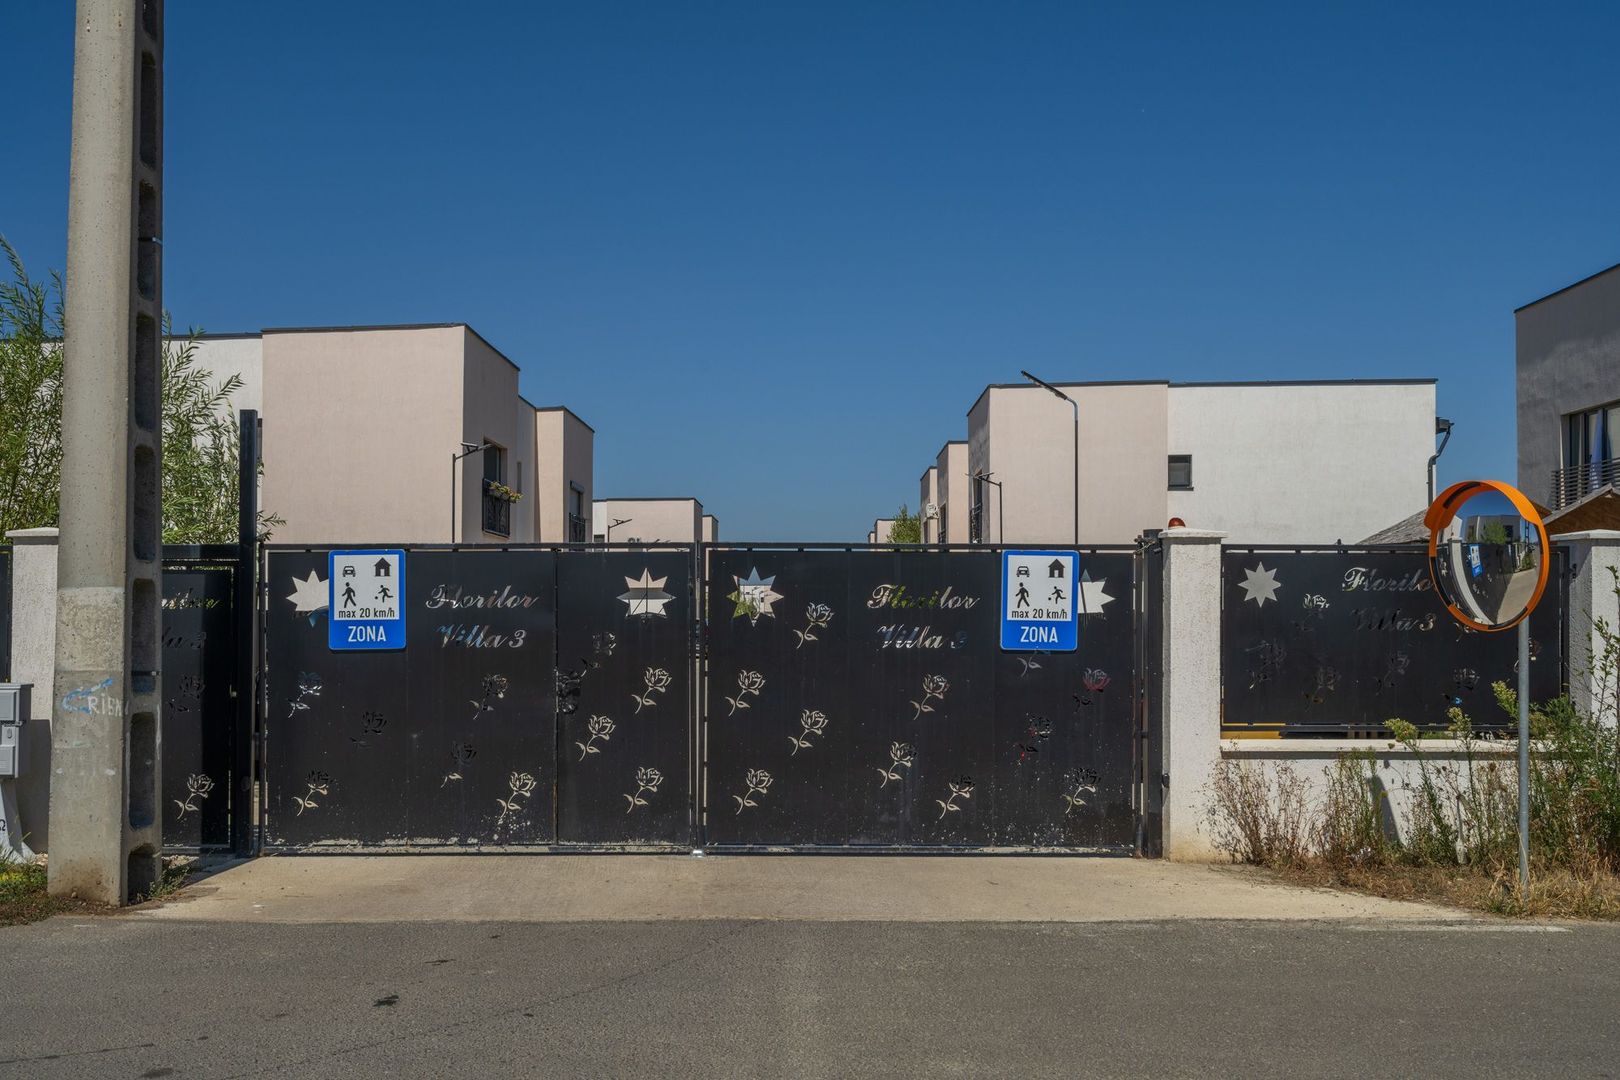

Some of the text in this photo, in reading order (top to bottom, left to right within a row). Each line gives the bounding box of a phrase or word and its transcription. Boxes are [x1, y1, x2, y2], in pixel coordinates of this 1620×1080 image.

[1341, 567, 1434, 592] Florilo
[426, 584, 539, 609] Florilor
[867, 584, 980, 609] Florilor
[338, 607, 395, 618] max 20 km/h
[1011, 608, 1068, 619] max 20 km/h
[347, 625, 387, 642] ZONA
[436, 624, 527, 648] Villa 3
[1020, 626, 1058, 643] ZONA
